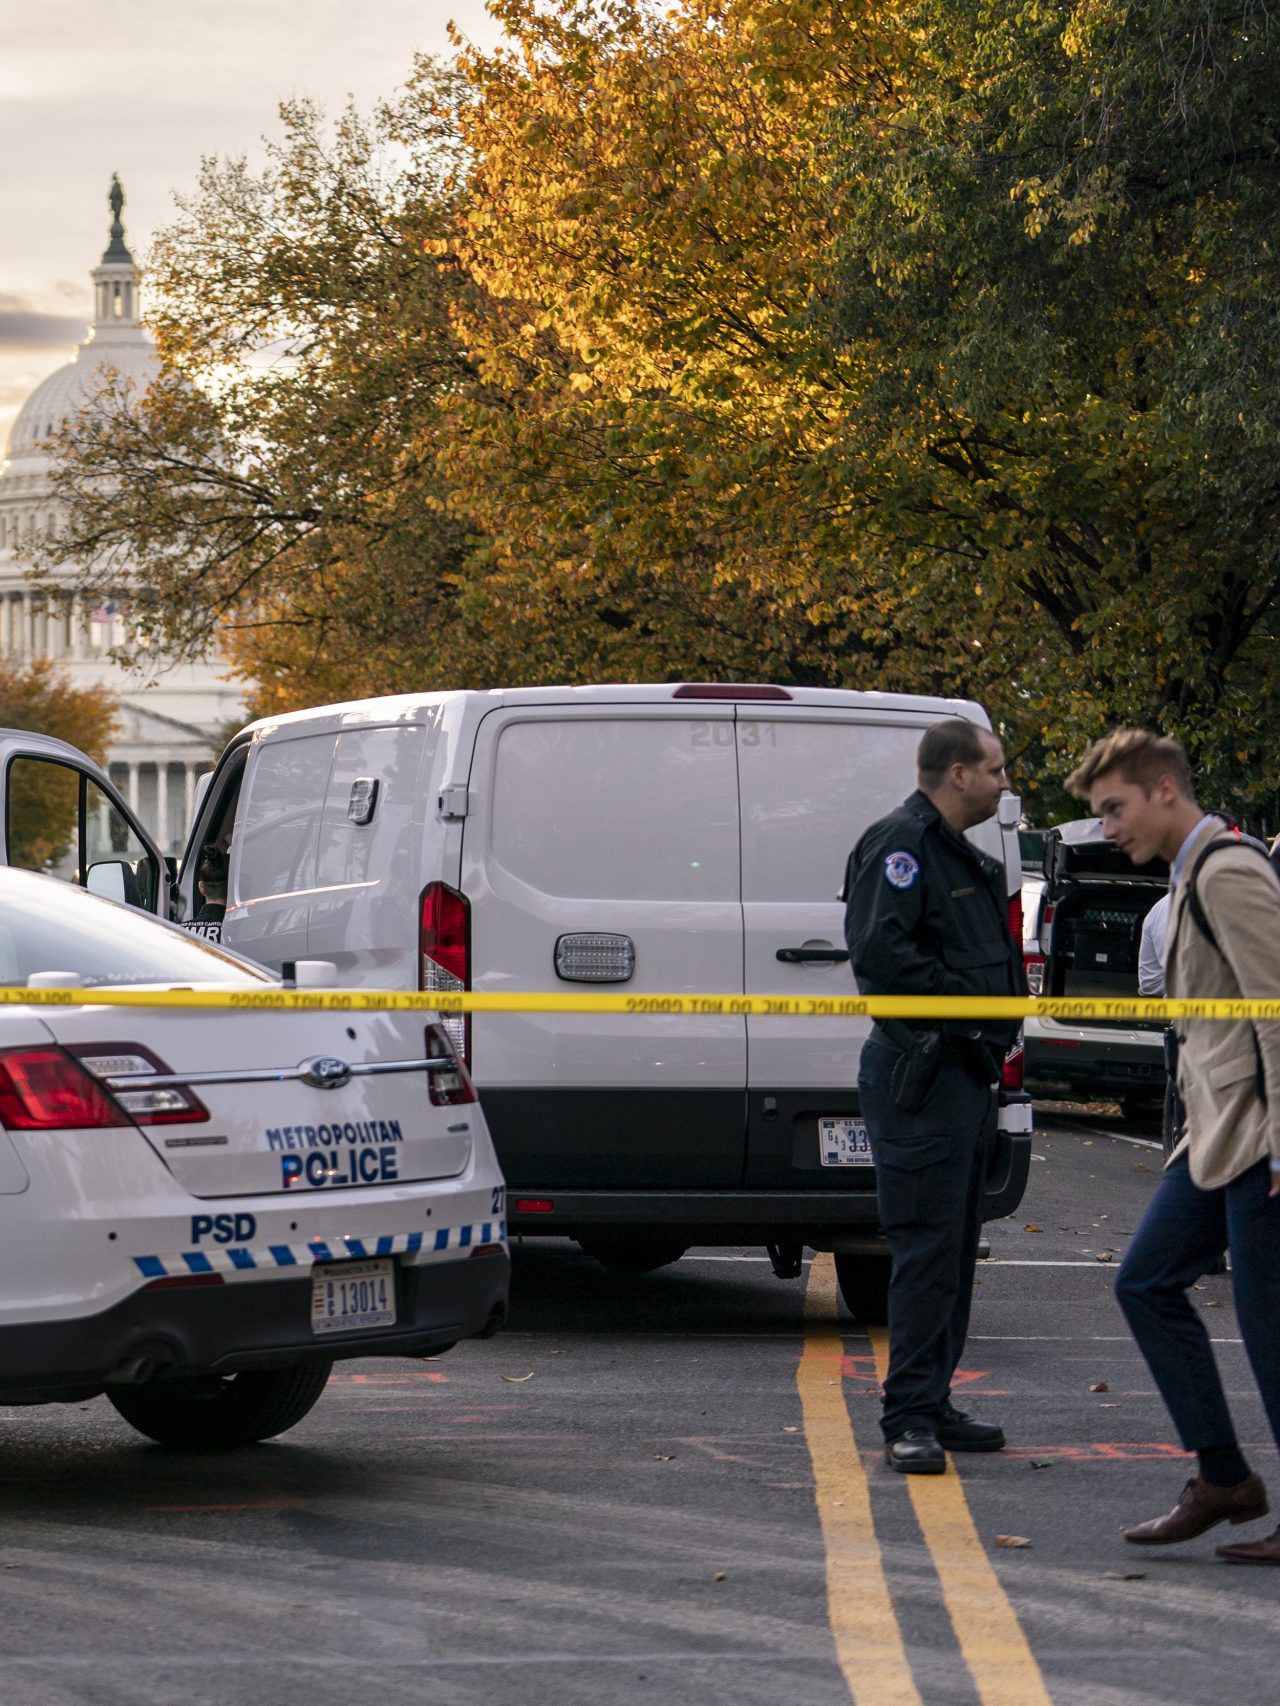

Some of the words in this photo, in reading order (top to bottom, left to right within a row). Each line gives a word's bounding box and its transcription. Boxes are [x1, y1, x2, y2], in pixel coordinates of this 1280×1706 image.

[690, 721, 777, 747] 2031
[266, 1120, 403, 1150] METROPOLITAN
[281, 1146, 398, 1188] POLICE
[191, 1213, 257, 1244] PSD
[340, 1278, 388, 1315] 13014
